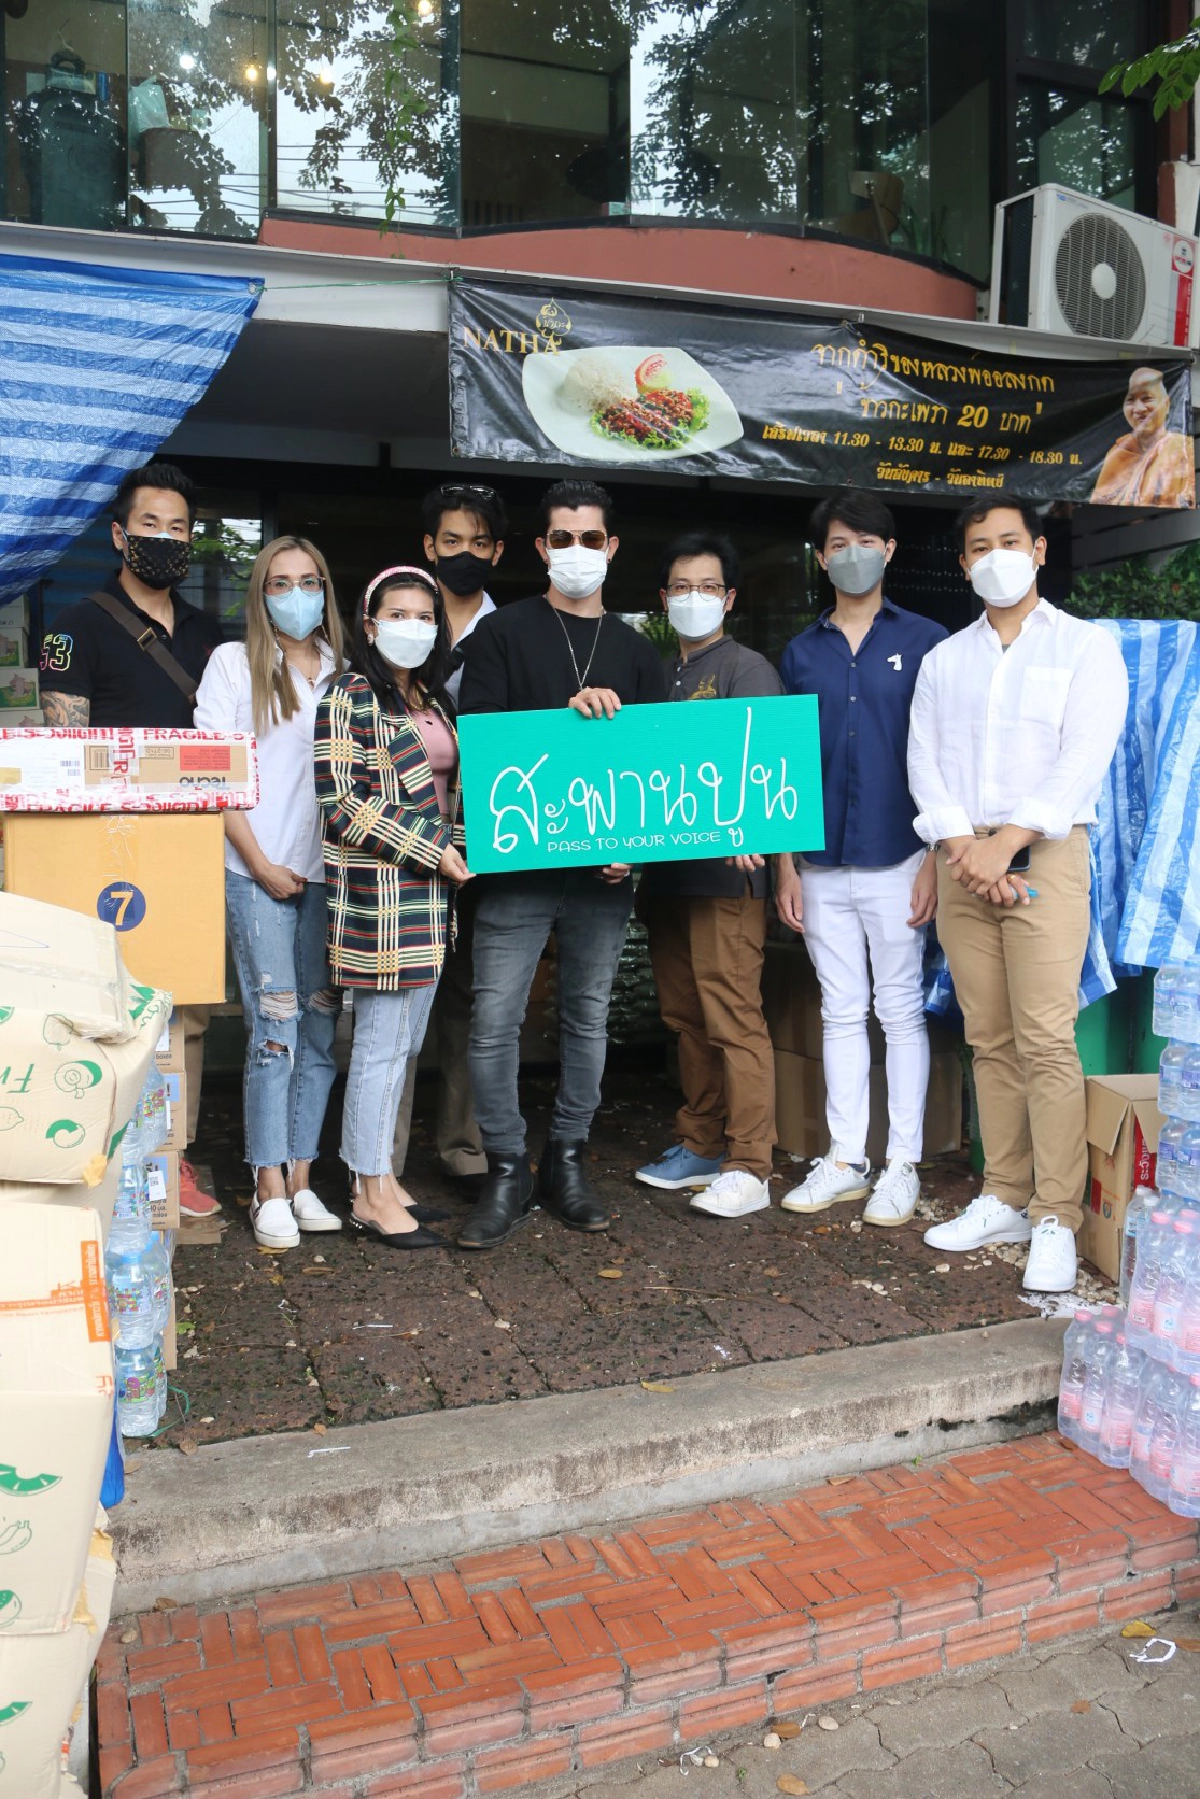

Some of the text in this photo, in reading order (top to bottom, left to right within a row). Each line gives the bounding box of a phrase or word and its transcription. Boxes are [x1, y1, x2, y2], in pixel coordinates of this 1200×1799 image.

[463, 327, 561, 356] NATHA
[957, 405, 989, 428] 20
[833, 432, 870, 447] 11.30
[888, 436, 924, 453] 13.30
[977, 445, 1010, 460] 17.30
[1029, 450, 1063, 464] 18.30
[143, 728, 225, 741] FRAGILE
[489, 706, 798, 853] สะพานปูน
[547, 831, 721, 853] PASS TO YOUR VOICE
[111, 892, 134, 926] 7
